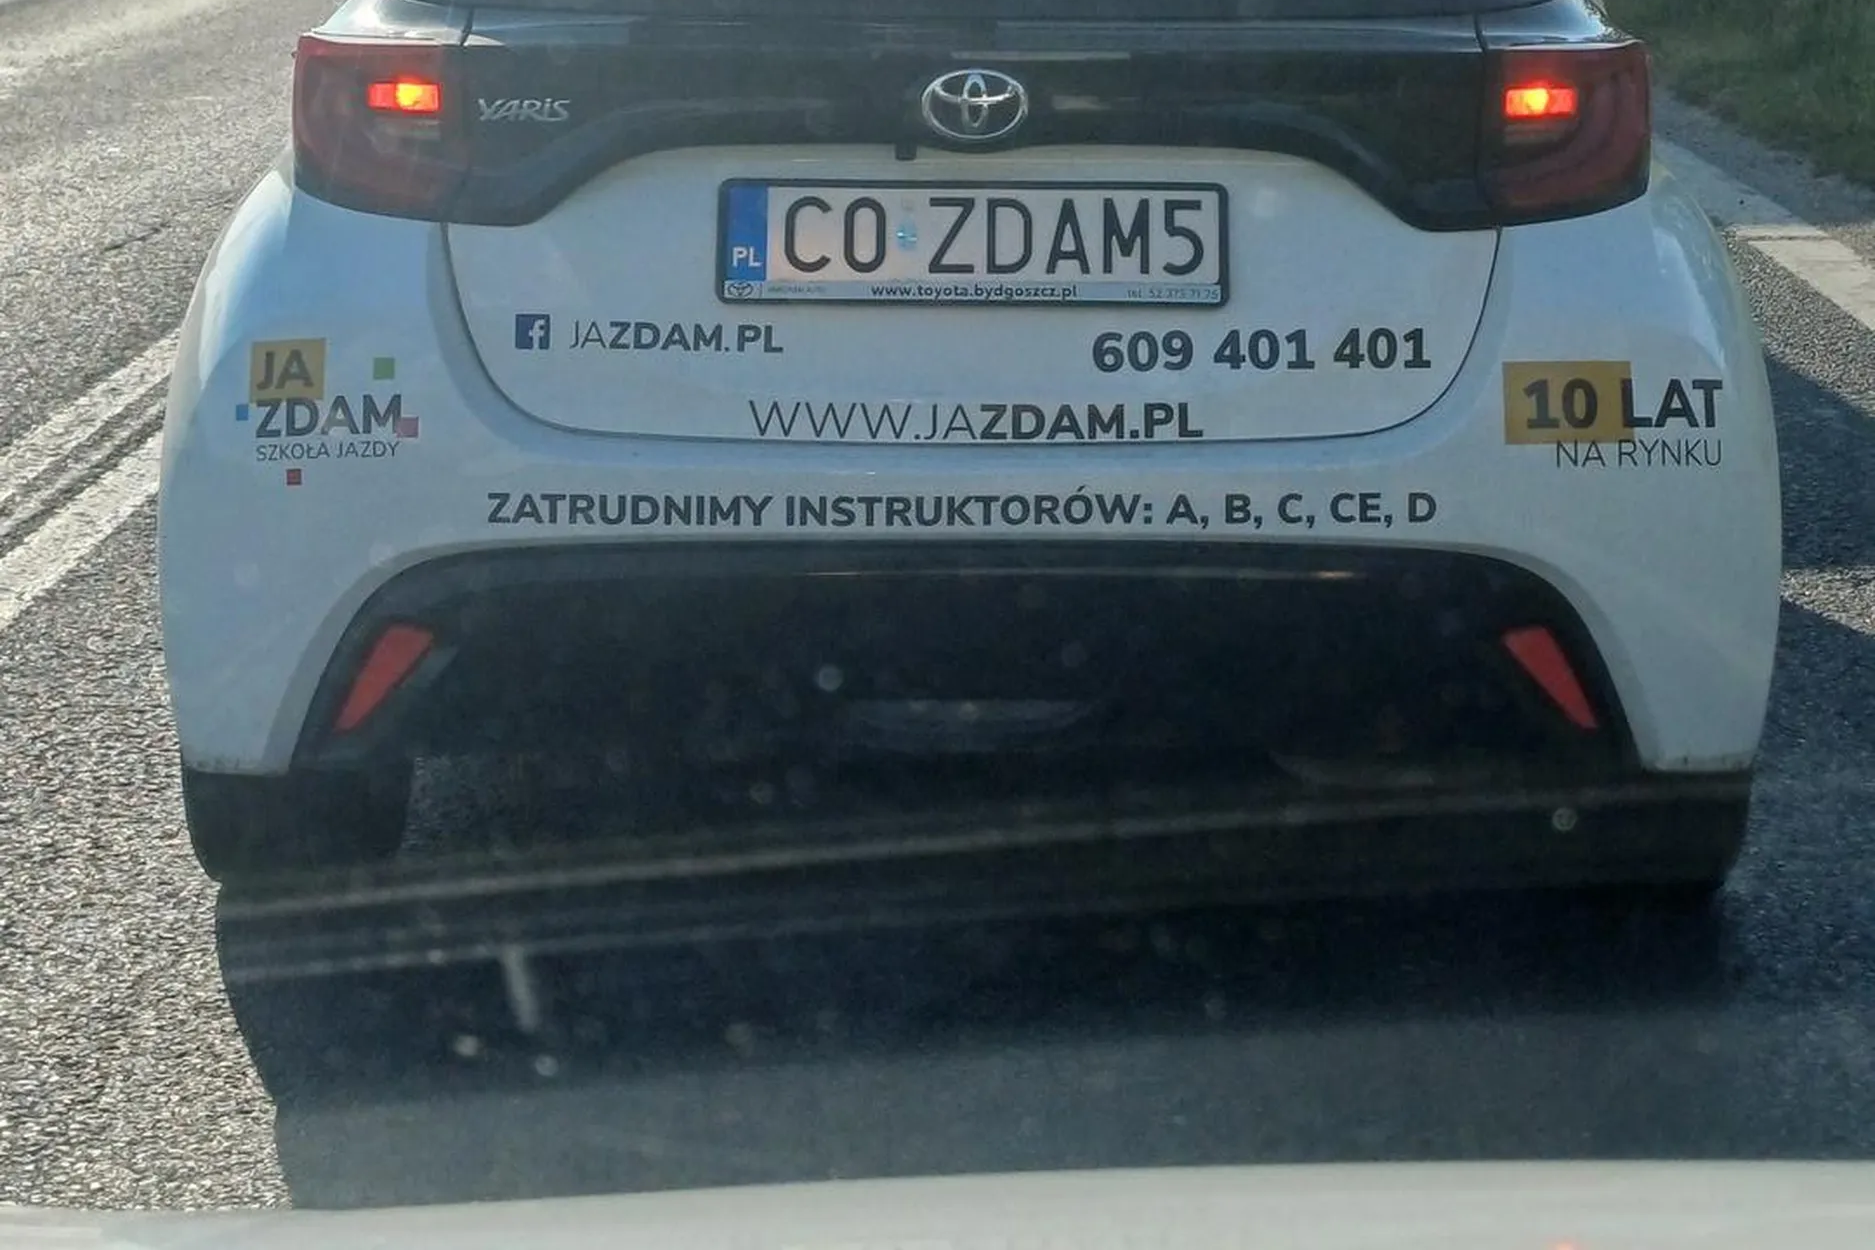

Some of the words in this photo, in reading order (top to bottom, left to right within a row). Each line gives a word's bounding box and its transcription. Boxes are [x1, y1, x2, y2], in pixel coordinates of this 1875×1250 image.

[477, 98, 571, 122] YARIS
[732, 247, 762, 267] PL
[928, 197, 1205, 276] ZDAM5
[871, 283, 1078, 299] www.toyota.bydgoszcz.pl
[569, 319, 784, 353] JAZDAM.PL
[1092, 330, 1194, 373] 609
[1213, 328, 1316, 370] 401
[1333, 327, 1432, 369] 401
[256, 349, 315, 390] JA
[255, 393, 402, 438] ZDAM
[749, 400, 1204, 441] WWW.JAZDAM.PL
[1523, 377, 1599, 430] 10
[1619, 377, 1723, 429] LAT
[256, 442, 330, 462] SZKOŁA
[336, 440, 400, 458] JAZDY
[1556, 439, 1607, 468] NA
[1618, 437, 1723, 468] RYNKU
[487, 492, 773, 526] ZATRUDNIMY
[786, 485, 1153, 527] INSTRUKTORÓW:
[1165, 493, 1210, 529] A,
[1225, 493, 1263, 530] B,
[1277, 493, 1316, 528] C,
[1330, 492, 1393, 528] CE,
[1408, 492, 1437, 524] D
